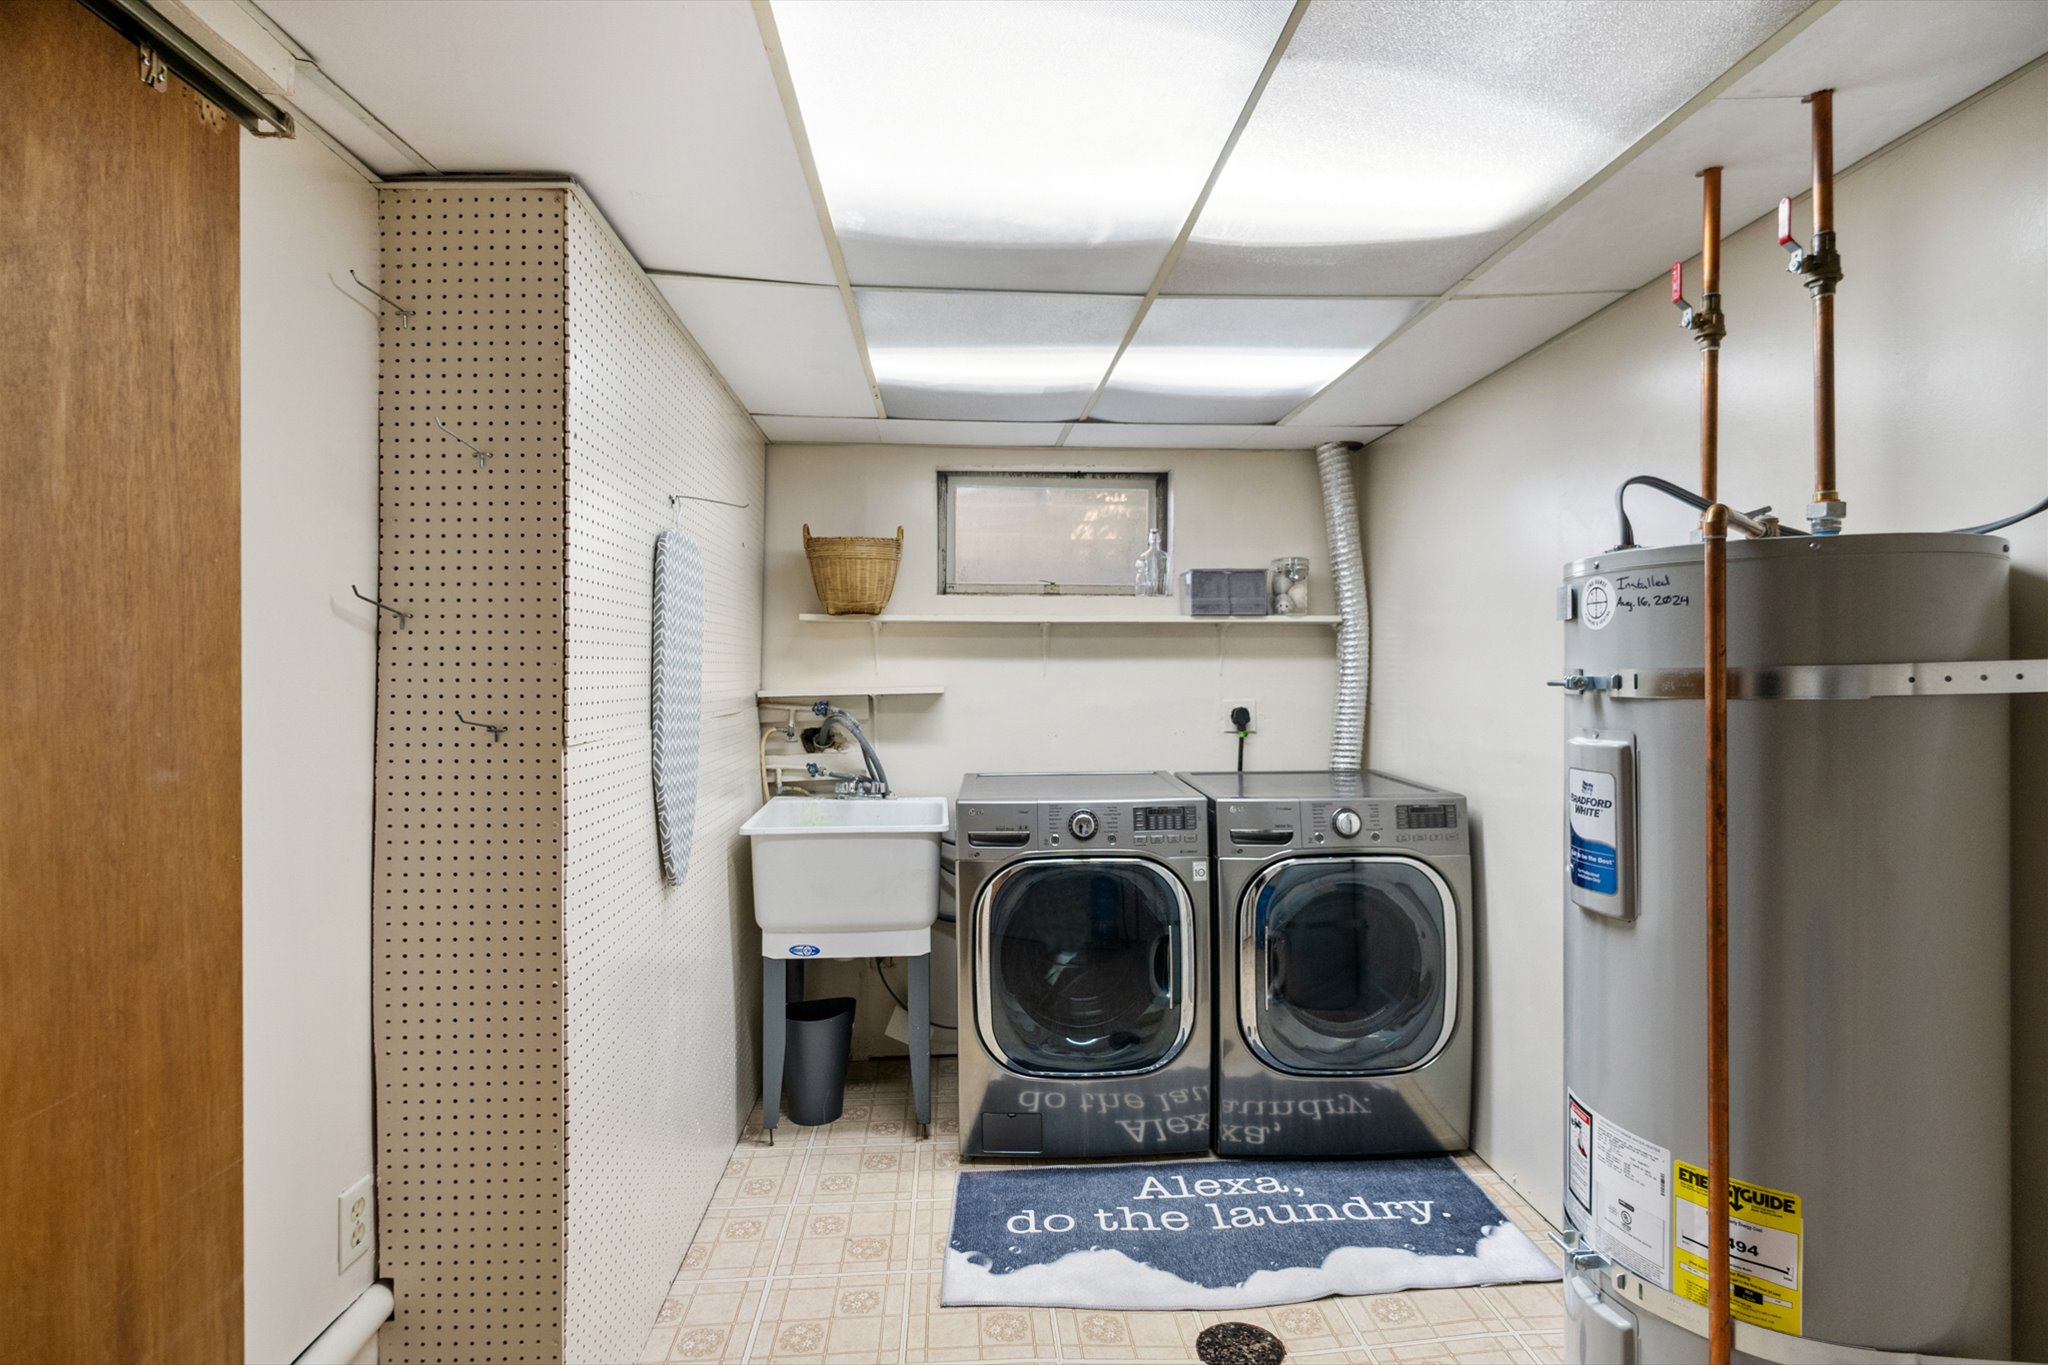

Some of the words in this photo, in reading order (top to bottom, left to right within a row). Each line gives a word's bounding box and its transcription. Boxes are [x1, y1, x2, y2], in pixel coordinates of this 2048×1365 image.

[1616, 574, 1670, 590] Installed
[1616, 596, 1635, 612] Aug.
[1653, 595, 1689, 606] 2024
[1571, 793, 1612, 809] BRADFORD
[1575, 804, 1600, 818] WHITE
[1133, 1175, 1304, 1200] Alexa,
[1678, 1166, 1796, 1214] ENEYGUIDE
[1006, 1209, 1075, 1234] do
[1094, 1206, 1190, 1232] the
[1205, 1196, 1451, 1230] laundry.
